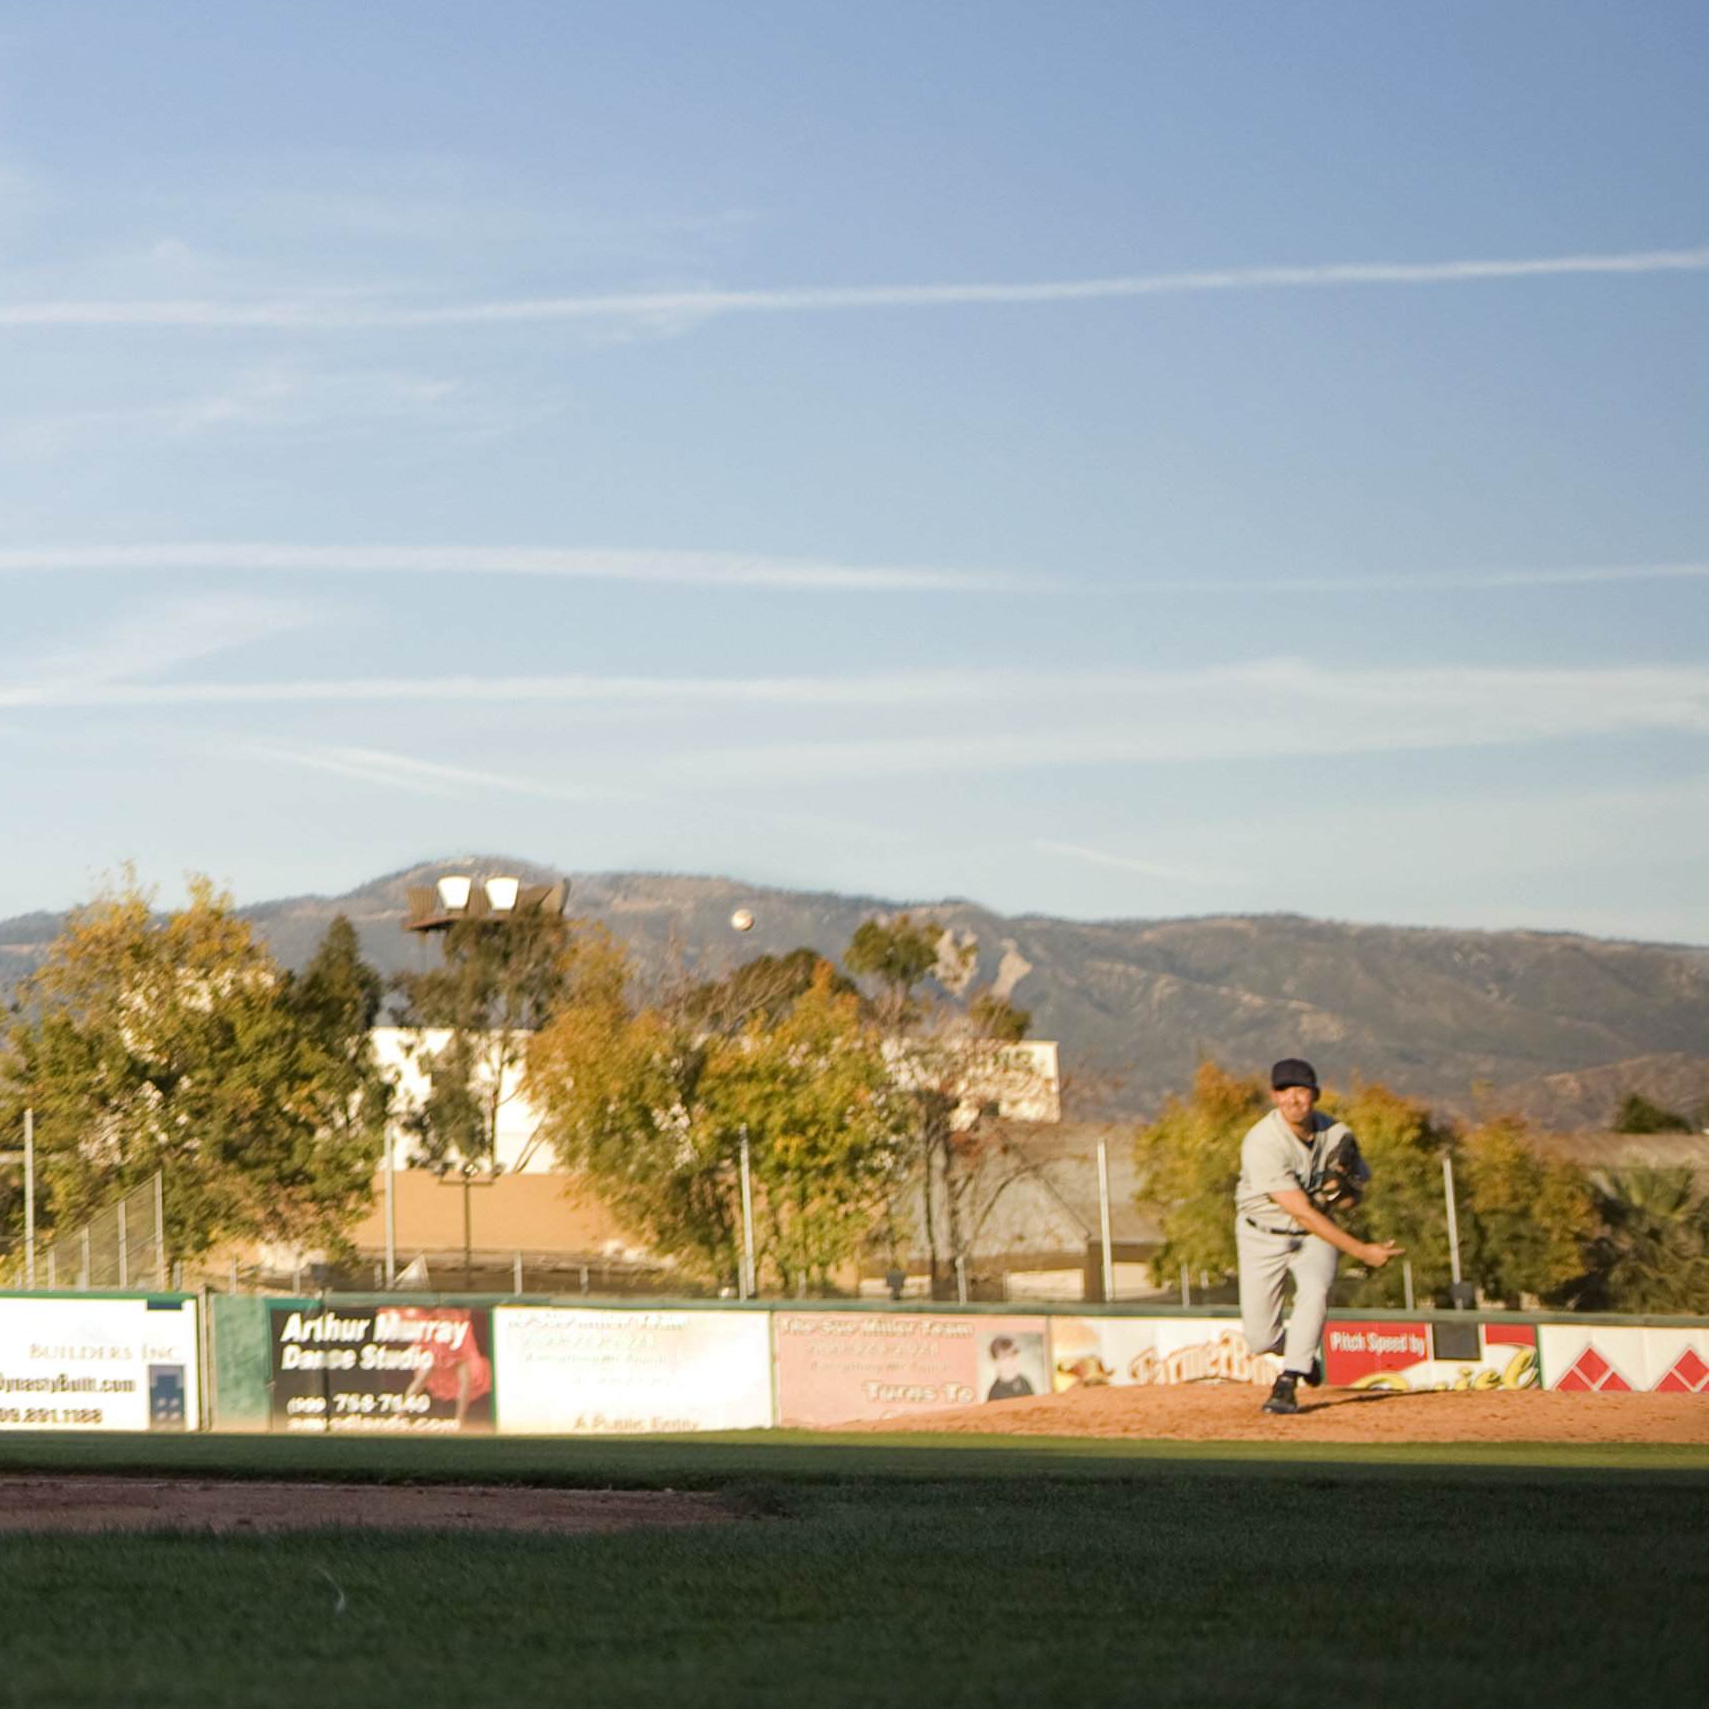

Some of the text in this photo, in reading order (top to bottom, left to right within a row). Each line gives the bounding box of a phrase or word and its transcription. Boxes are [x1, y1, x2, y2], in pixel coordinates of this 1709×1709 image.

[280, 1310, 470, 1351] Arthur Murray
[776, 1317, 974, 1339] The Sue Miller Team
[280, 1343, 435, 1371] Dance Studio
[1329, 1330, 1426, 1357] Pitch Speed by
[861, 1380, 977, 1404] Turns To
